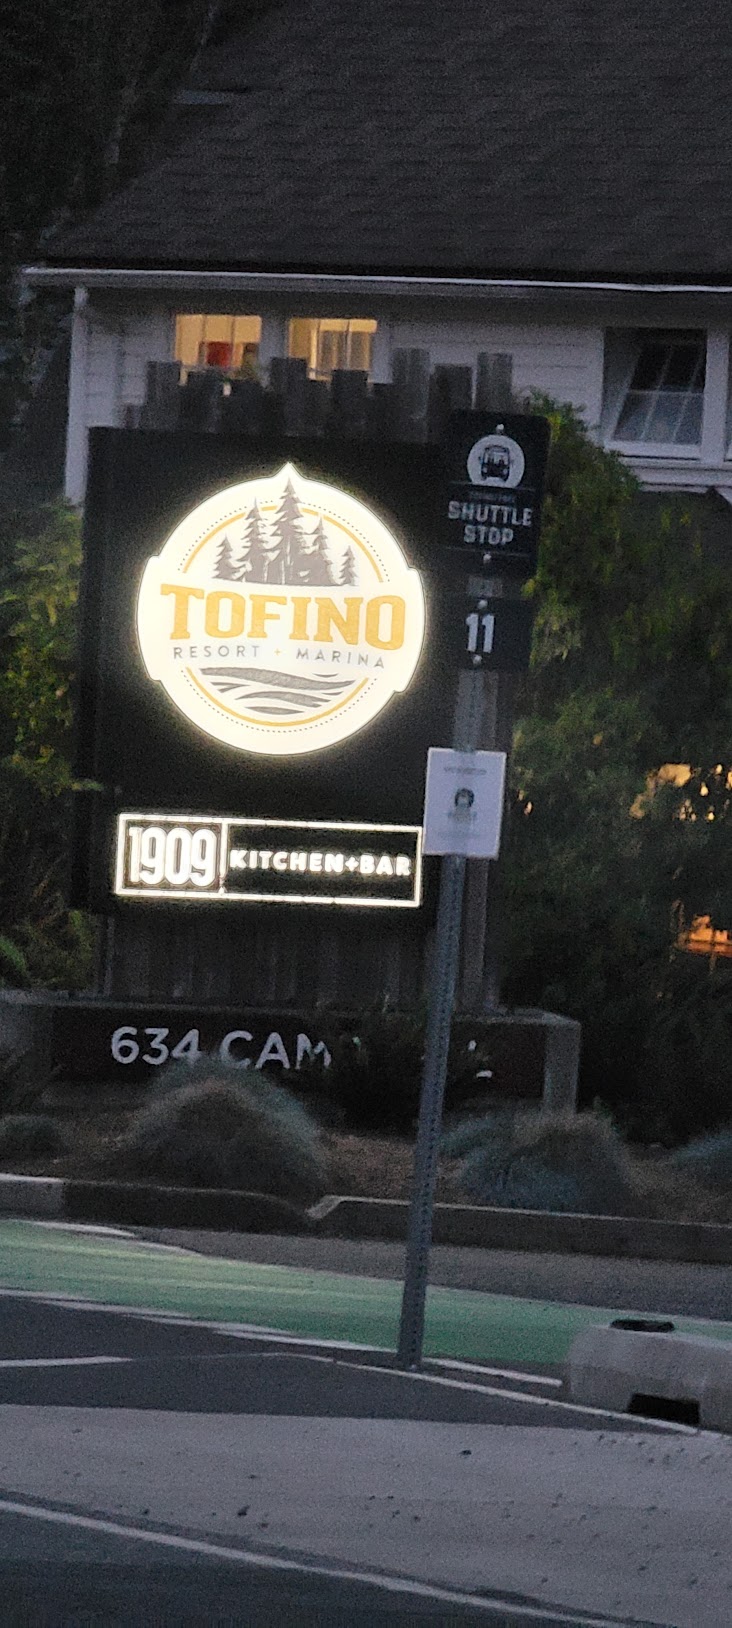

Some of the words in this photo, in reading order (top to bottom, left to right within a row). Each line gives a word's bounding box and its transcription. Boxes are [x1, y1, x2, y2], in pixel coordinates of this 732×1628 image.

[448, 500, 532, 526] SHUTTLE
[463, 525, 514, 546] STOP
[160, 583, 406, 651] TOFINO
[465, 613, 496, 654] 11
[173, 645, 260, 659] RESORT
[296, 648, 385, 669] MARINA
[129, 826, 217, 887] 1909
[111, 1026, 201, 1065] 634
